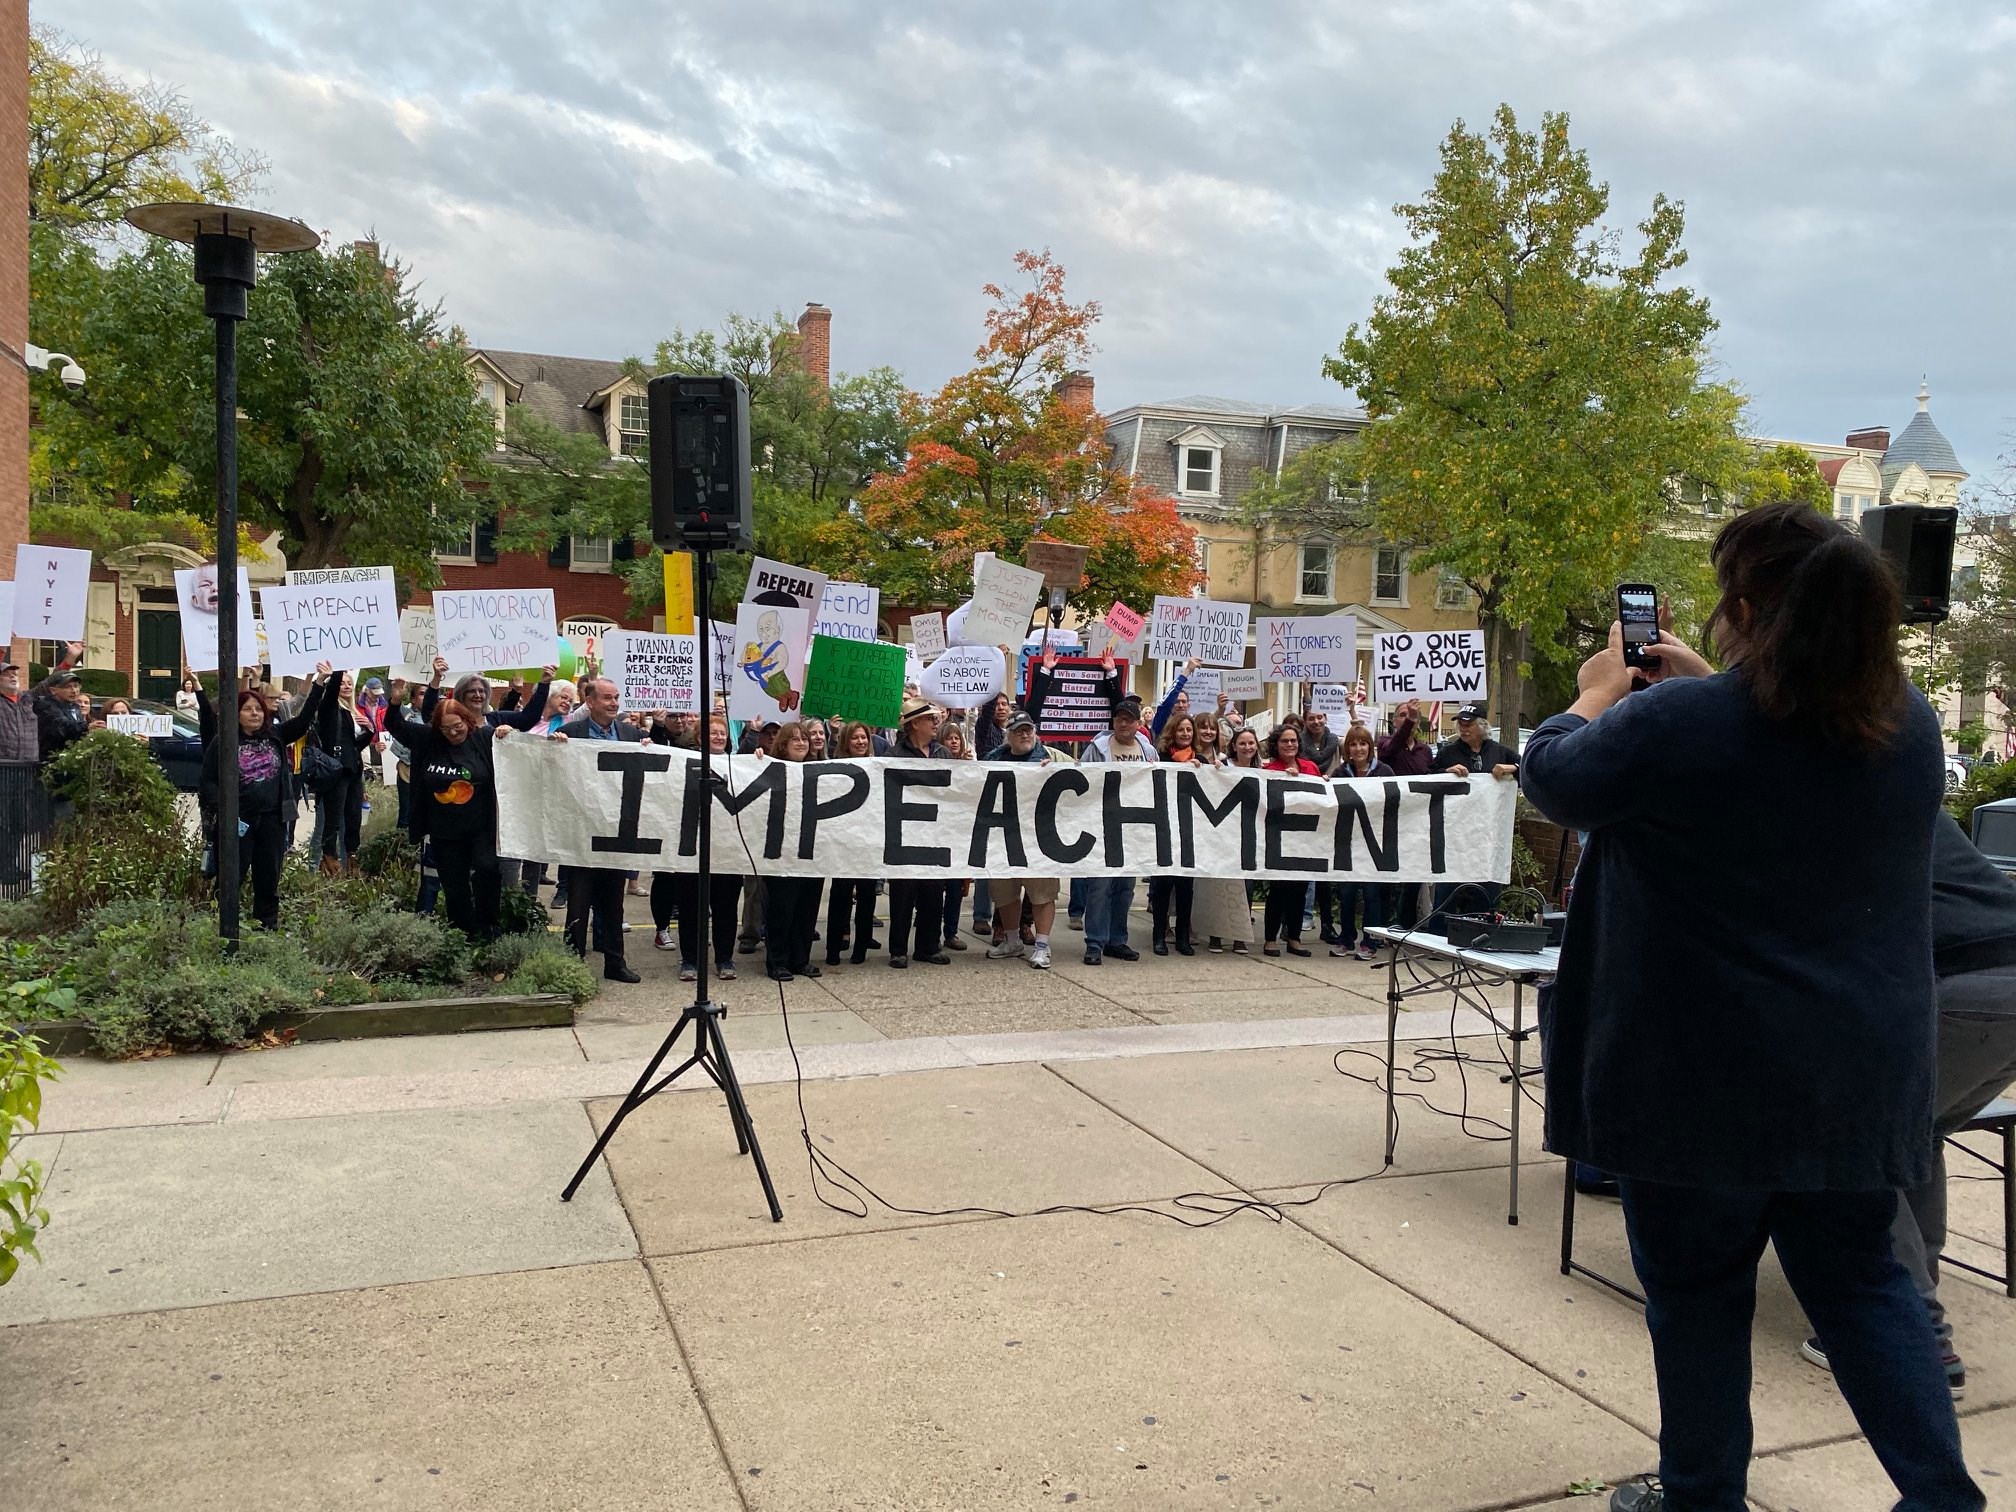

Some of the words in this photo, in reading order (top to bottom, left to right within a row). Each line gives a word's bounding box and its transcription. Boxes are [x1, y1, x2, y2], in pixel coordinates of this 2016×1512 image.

[293, 568, 380, 586] IMPEACH
[992, 565, 1035, 586] JUST
[42, 560, 58, 626] NYET
[756, 571, 814, 599] REPEAL
[979, 578, 1029, 603] FOLLOW
[278, 595, 379, 621] IMPEACH
[442, 594, 549, 620] DEMOCRACY
[821, 586, 870, 614] fend
[995, 597, 1018, 613] THE
[410, 616, 436, 630] INC
[914, 617, 939, 628] OMG
[977, 607, 1023, 632] MONEY
[1117, 607, 1138, 626] DUMP
[1207, 610, 1244, 628] WOULD
[488, 624, 506, 640] VS
[567, 624, 611, 639] HONK
[813, 619, 877, 644] emocracy
[916, 627, 941, 638] GOP
[1109, 618, 1134, 638] TRUMP
[1155, 623, 1176, 639] LIKE
[1180, 624, 1195, 641] YOU
[1199, 625, 1211, 642] TO
[1213, 627, 1227, 644] DO
[1230, 629, 1243, 645] US
[1270, 621, 1295, 636] MY
[287, 625, 381, 654] REMOVE
[586, 637, 595, 655] 2
[626, 638, 632, 654] I
[636, 639, 676, 655] WANNA
[679, 640, 694, 655] GO
[918, 637, 942, 649] WTF
[1270, 635, 1342, 650] ATTORNEYS
[1381, 634, 1413, 652] NO
[1426, 633, 1471, 650] ONE
[401, 641, 439, 664] IMP
[465, 642, 529, 666] TRUMP
[830, 643, 841, 657] IF
[846, 645, 865, 662] YOU
[866, 648, 901, 667] REPEAT
[1153, 640, 1162, 654] A
[1164, 640, 1193, 658] FAVOR
[1270, 651, 1302, 665] GET
[625, 654, 656, 664] APPLE
[657, 655, 693, 665] PICKING
[1381, 653, 1401, 671] IS
[1415, 649, 1485, 670] ABOVE
[625, 664, 656, 676] WEAR
[654, 665, 693, 677] SCARVES
[827, 662, 836, 676] A
[841, 664, 858, 679] LIE
[862, 666, 898, 685] OFTEN
[940, 667, 951, 678] IS
[953, 667, 990, 678] ABOVE
[1057, 670, 1076, 679] Who
[1081, 671, 1101, 679] Sows
[1269, 663, 1331, 678] ARRESTED
[625, 674, 650, 686] drink
[654, 674, 669, 687] hot
[671, 676, 692, 687] cider
[940, 682, 963, 692] THE
[966, 682, 989, 692] LAW
[1064, 684, 1093, 692] Hatred
[1378, 674, 1417, 692] THE
[1428, 671, 1482, 692] LAW
[625, 686, 631, 698] &
[634, 687, 667, 698] IMPEACH
[669, 688, 693, 700] TRUMP
[1314, 688, 1328, 696] NO
[625, 699, 637, 709] YOU
[659, 700, 673, 709] FALL
[675, 700, 692, 710] STUFF
[808, 694, 896, 724] REPUBLICAN
[1045, 696, 1070, 707] Reaps
[1075, 697, 1108, 705] Violence
[109, 716, 171, 734] IMPEACH!
[1057, 722, 1079, 730] Their
[1083, 723, 1107, 731] Hands
[591, 752, 1471, 874] IMPEACHMENT
